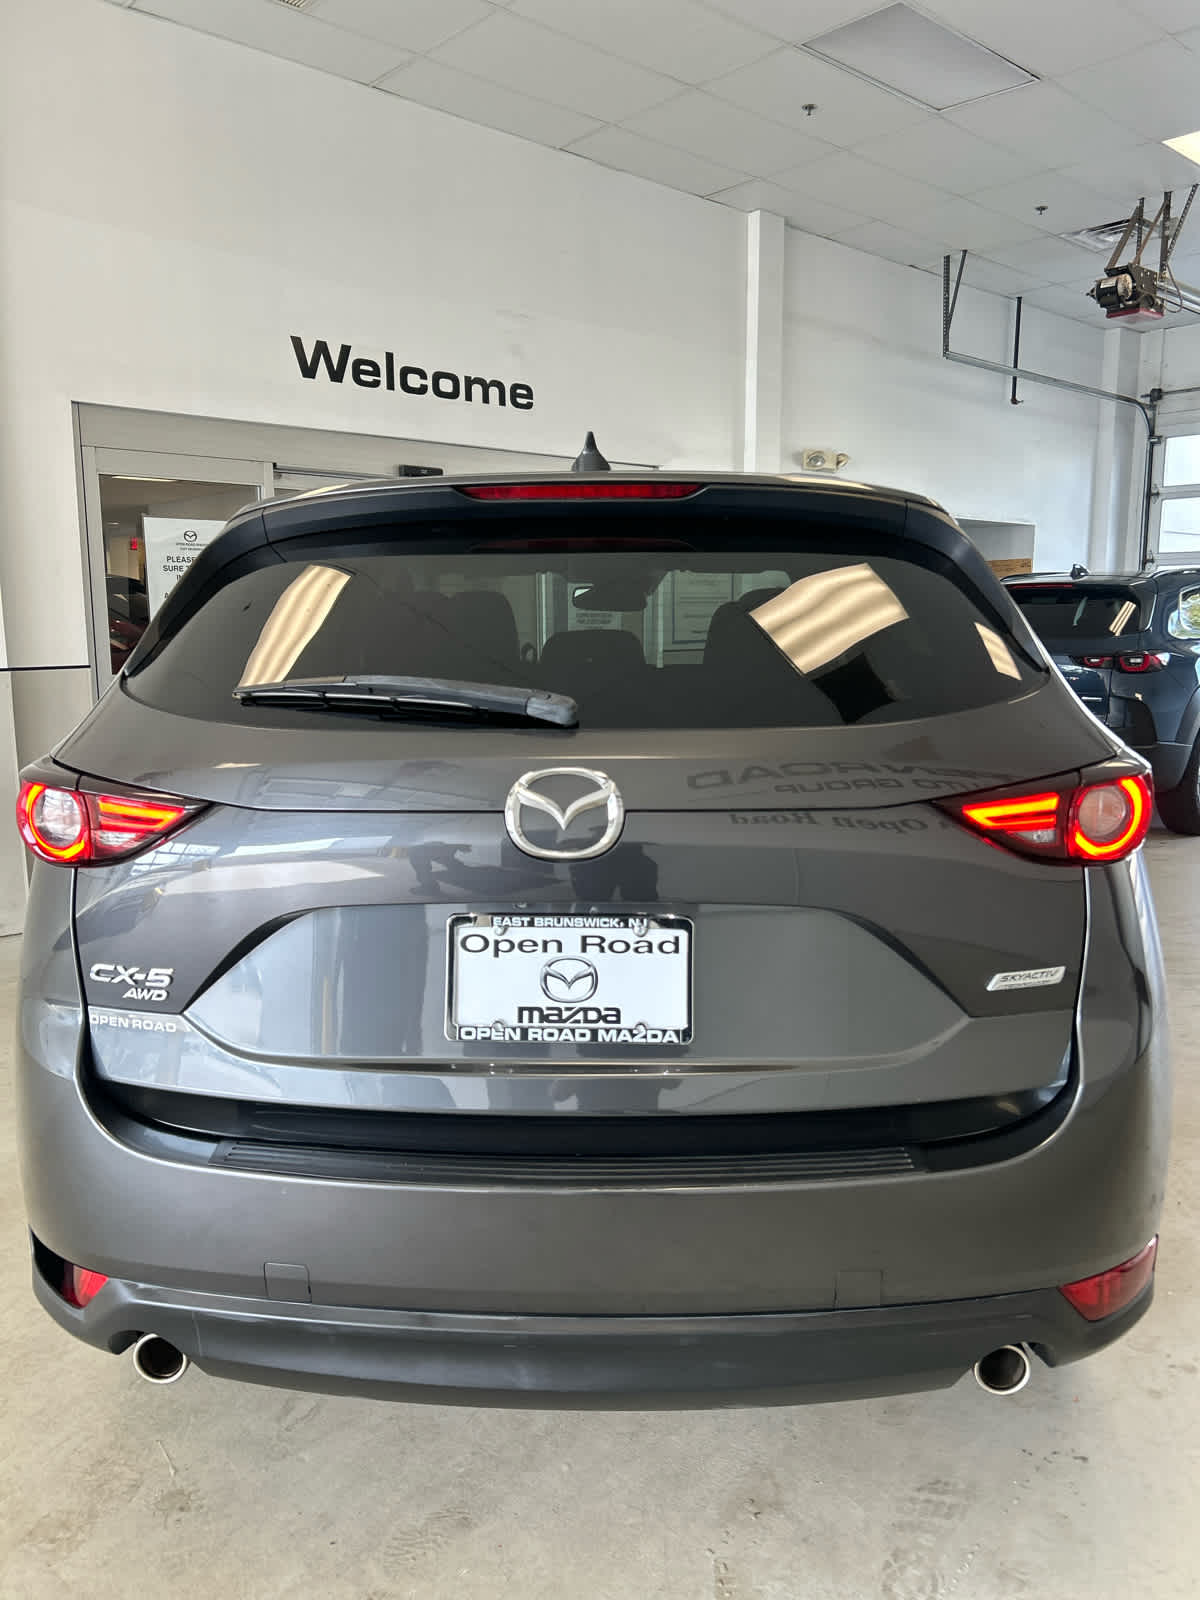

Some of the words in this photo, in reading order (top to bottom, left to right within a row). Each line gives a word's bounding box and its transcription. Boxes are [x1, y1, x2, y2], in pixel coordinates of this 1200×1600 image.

[290, 335, 534, 410] Welcome
[493, 916, 531, 928] EAST
[534, 916, 624, 928] BRUNSWICK,
[628, 917, 648, 929] NJ
[460, 934, 563, 958] Open
[580, 935, 680, 954] Road
[89, 963, 174, 988] CX-5
[1000, 968, 1060, 983] SKYACTIV
[122, 988, 168, 1001] AWD
[90, 1014, 129, 1029] OPEN
[132, 1018, 177, 1033] ROAD
[461, 1026, 520, 1041] OPEN
[528, 1027, 591, 1042] ROAD
[598, 1028, 680, 1043] MAZDA
